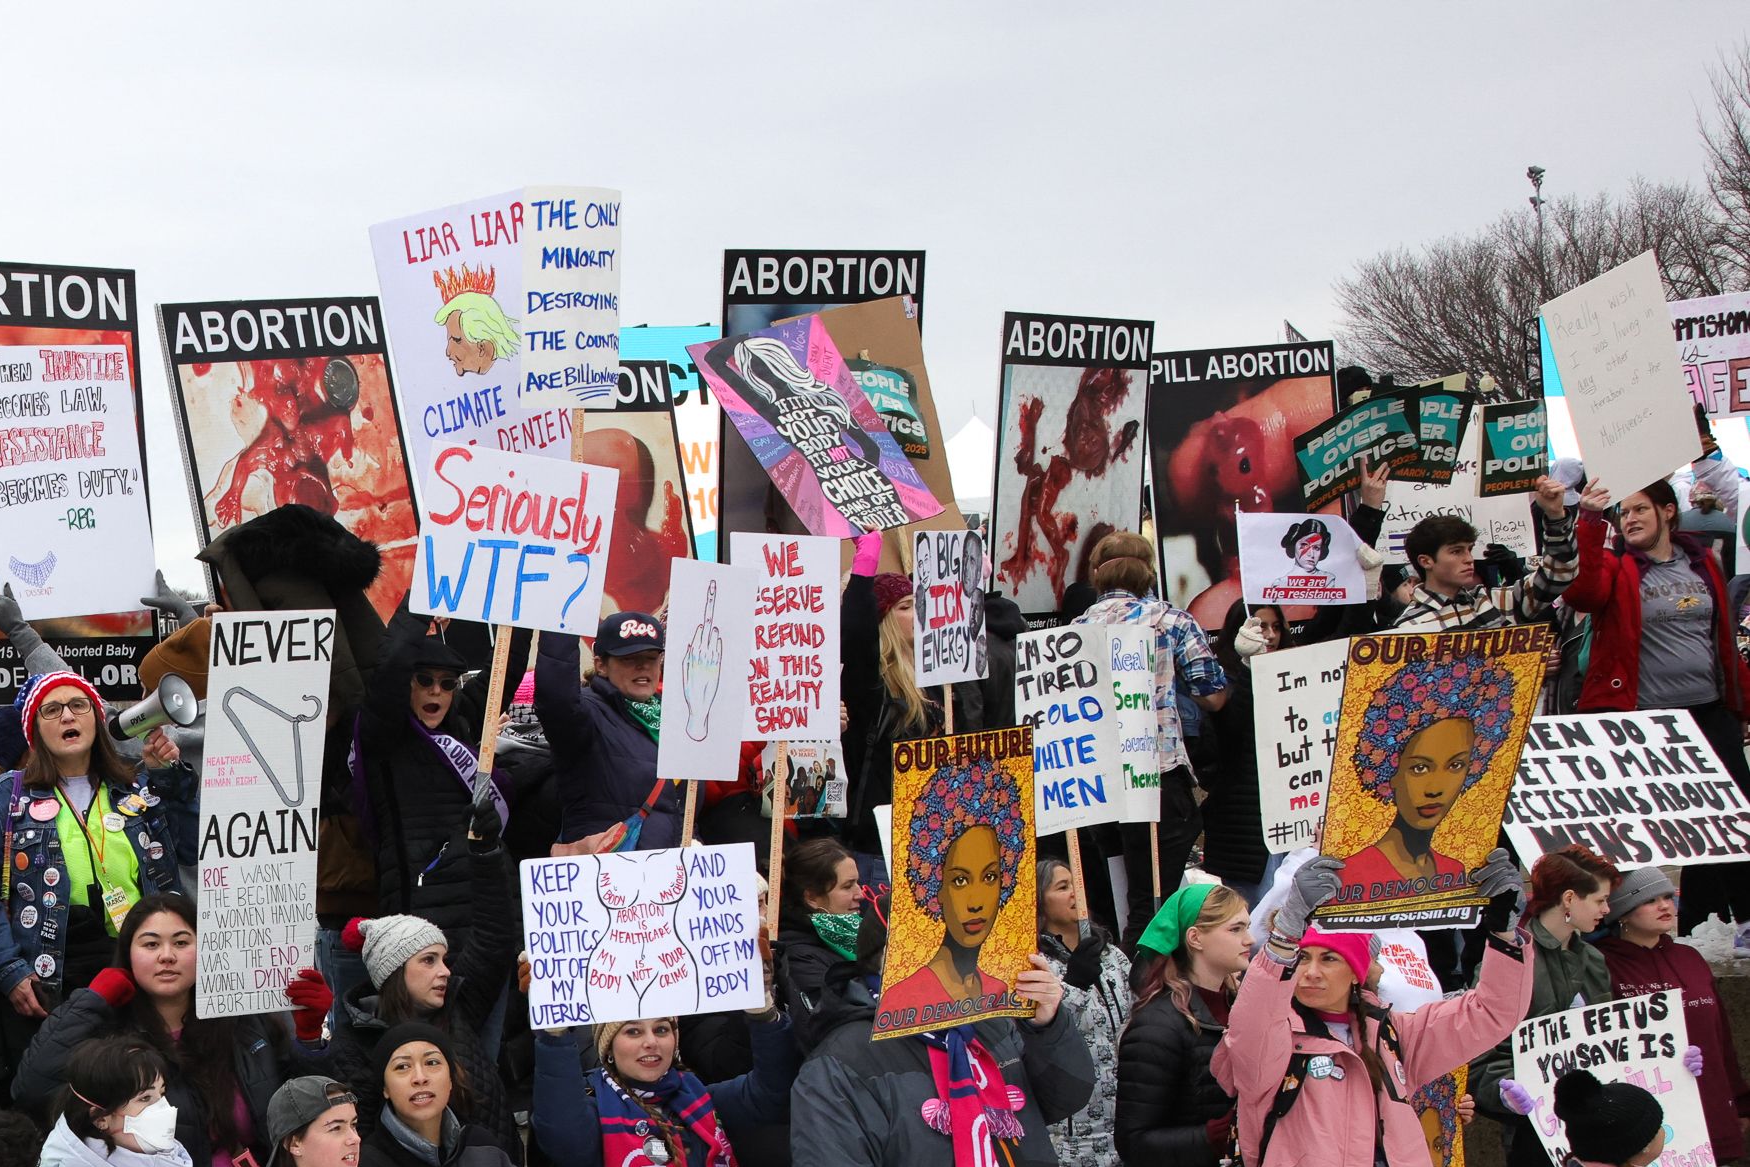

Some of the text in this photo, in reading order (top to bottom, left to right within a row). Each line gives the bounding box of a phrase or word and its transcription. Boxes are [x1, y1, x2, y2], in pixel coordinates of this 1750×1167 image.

[531, 199, 620, 231] THE ONLY
[542, 247, 615, 271] MINORITY
[727, 257, 918, 296] ABORTION
[527, 291, 618, 315] DESTROYING
[174, 304, 379, 355] ABORTION
[1005, 320, 1149, 362] ABORTION
[1150, 348, 1330, 385] PILL ABORTION
[1306, 397, 1406, 456] PEOPLE
[796, 432, 842, 455] BODY
[1322, 421, 1389, 465] OVER
[821, 468, 893, 504] CHOICE
[837, 491, 895, 518] BANS OFF
[762, 542, 804, 578] WE
[936, 534, 961, 580] BIG
[423, 534, 590, 629] WTF?
[1264, 587, 1345, 599] the resistance
[1288, 576, 1326, 587] we are
[929, 582, 966, 629] ICK
[211, 617, 335, 667] NEVER
[619, 618, 657, 638] Roe
[755, 623, 825, 650] REFUND
[922, 625, 971, 674] ENERGY
[1351, 626, 1544, 666] OUR FUTURE
[779, 655, 823, 677] THIS
[749, 680, 824, 710] REALITY
[130, 712, 147, 727] PYLE
[755, 705, 809, 735] SHOW
[1608, 715, 1690, 746] DO I
[206, 754, 252, 767] HEALTHCARE
[894, 728, 1033, 773] OUR FUTURE
[1570, 747, 1718, 782] TO MAKE
[205, 776, 258, 787] HUMAN RIGHT
[218, 767, 235, 776] IS A
[1288, 770, 1324, 790] can
[1042, 775, 1107, 811] MEN
[1289, 791, 1320, 811] me
[199, 808, 318, 861] AGAIN
[530, 862, 580, 895] KEEP
[690, 853, 726, 878] AND
[532, 900, 589, 928] YOUR
[689, 913, 744, 940] HANDS
[530, 930, 600, 954] POLITICS
[701, 938, 755, 966] OFF MY
[201, 945, 313, 972] WAS THE END OF
[201, 968, 295, 993] WOMEN DYING
[705, 968, 749, 998] BODY
[532, 1003, 591, 1026] UTERUS
[1519, 992, 1669, 1055] IF THE FETUS
[1310, 1057, 1331, 1069] ERA
[1312, 1067, 1332, 1078] YES
